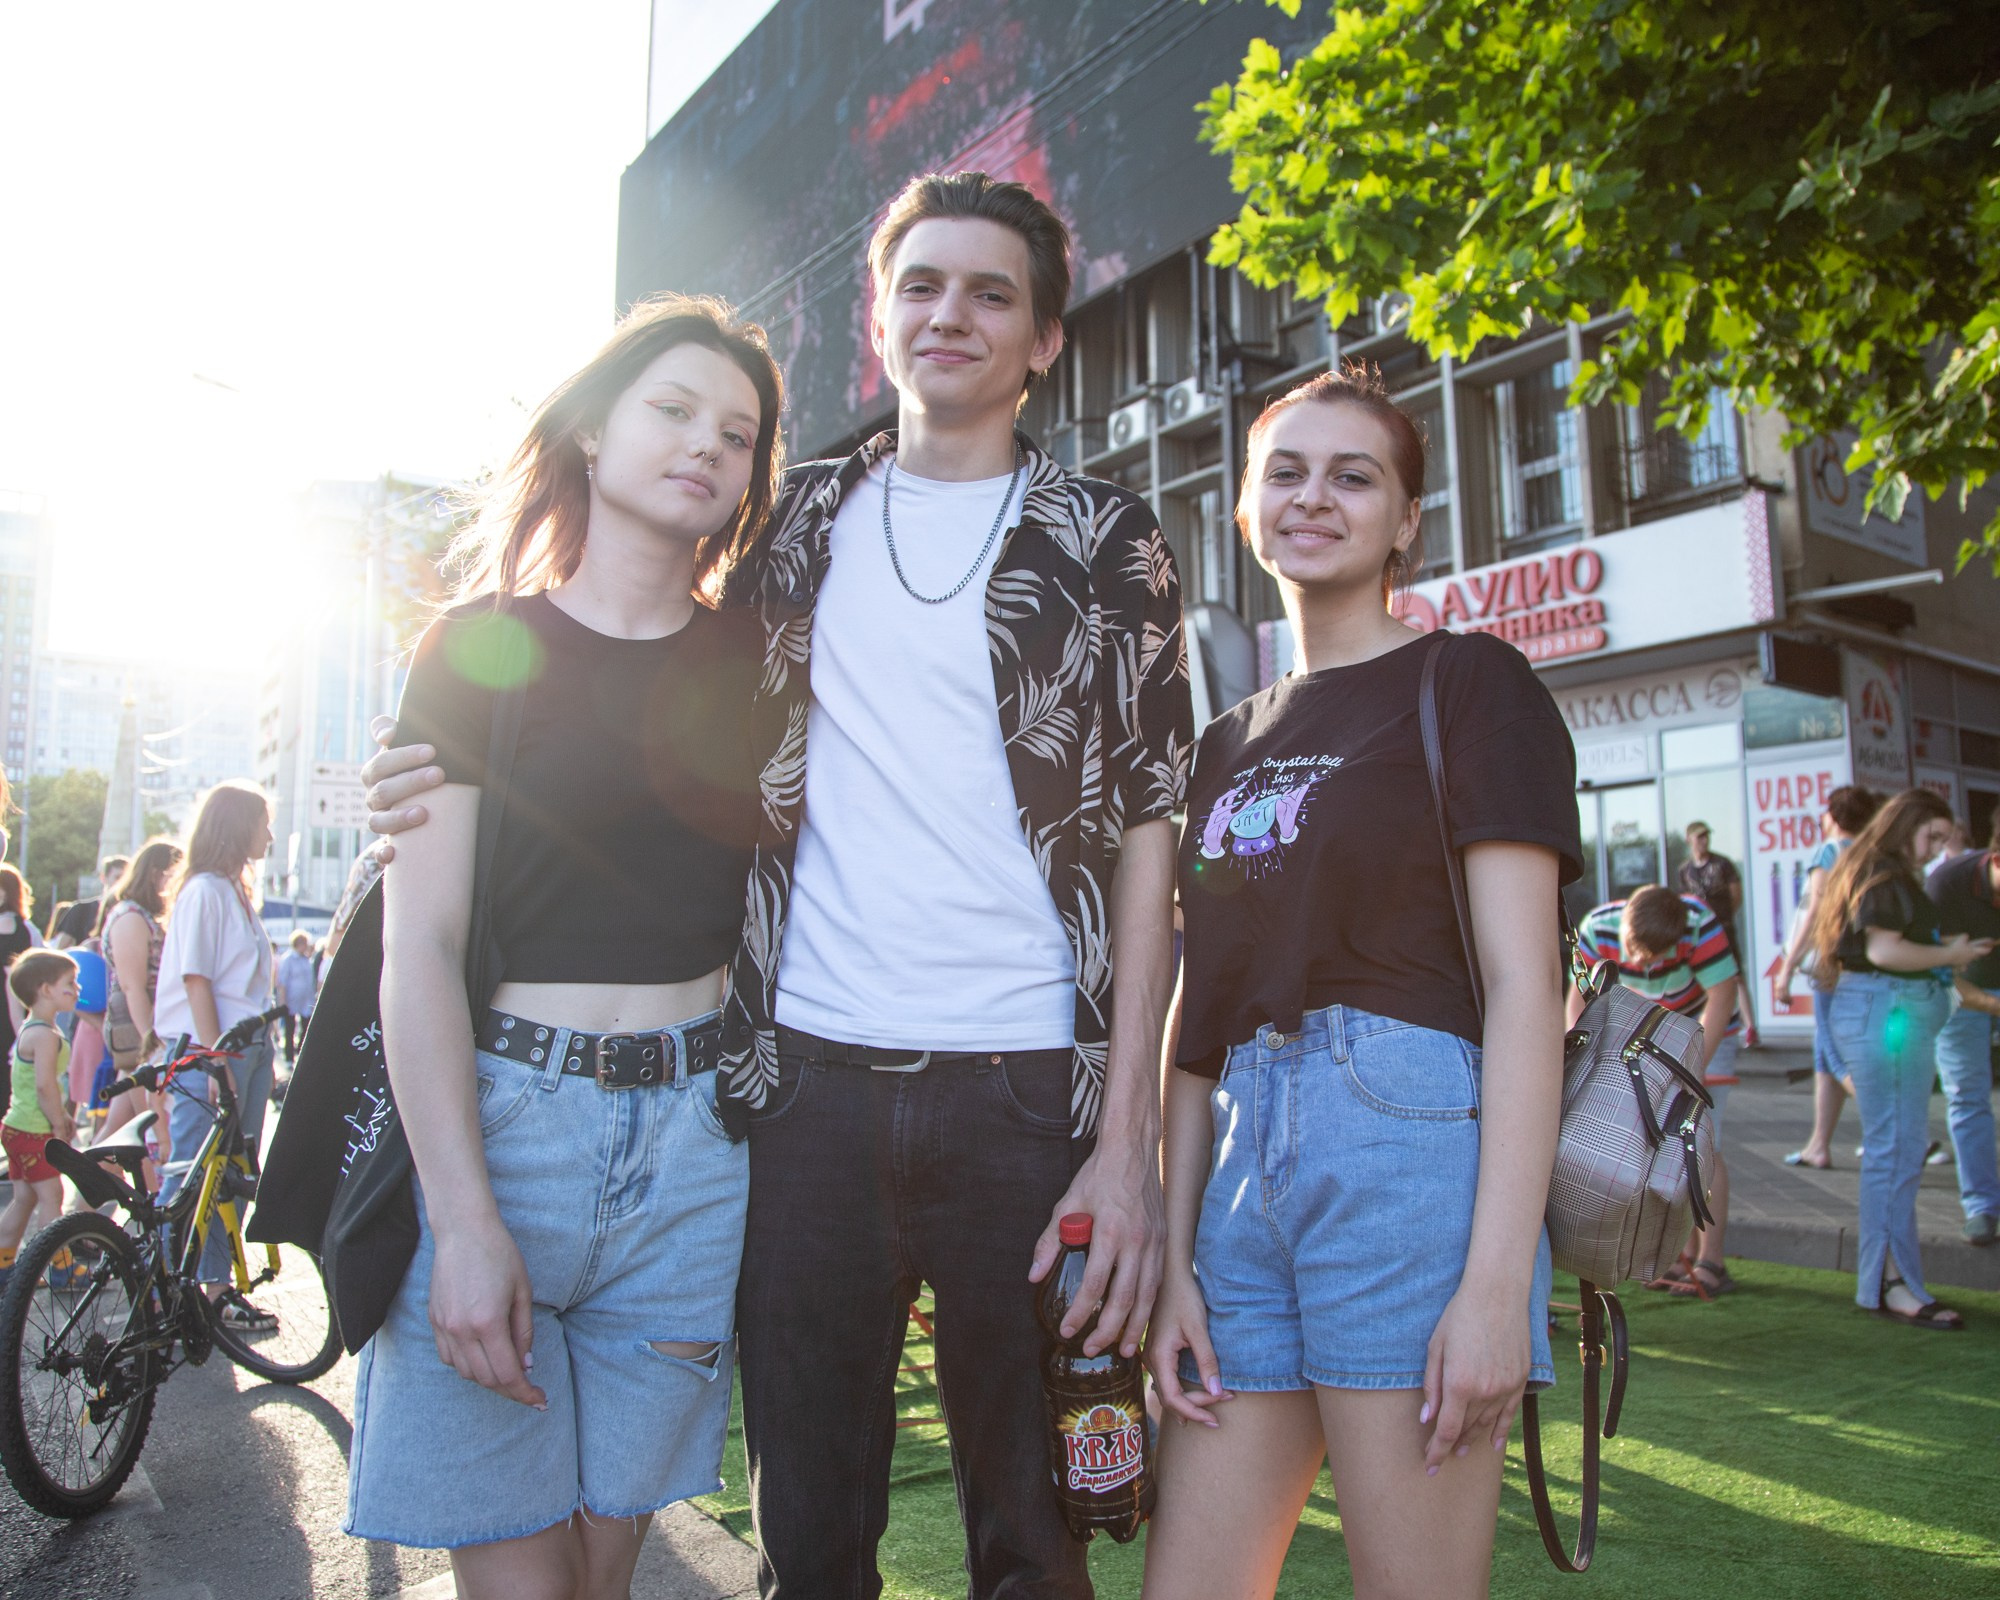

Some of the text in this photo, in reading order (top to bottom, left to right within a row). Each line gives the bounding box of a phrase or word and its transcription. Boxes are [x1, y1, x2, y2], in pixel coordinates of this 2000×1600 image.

[1440, 548, 1603, 626] АУДИО
[1464, 600, 1605, 642] иника
[1829, 711, 1843, 737] 3
[1262, 754, 1317, 774] Crystal
[1577, 743, 1645, 767] ODELS
[1755, 771, 1833, 813] VAPE
